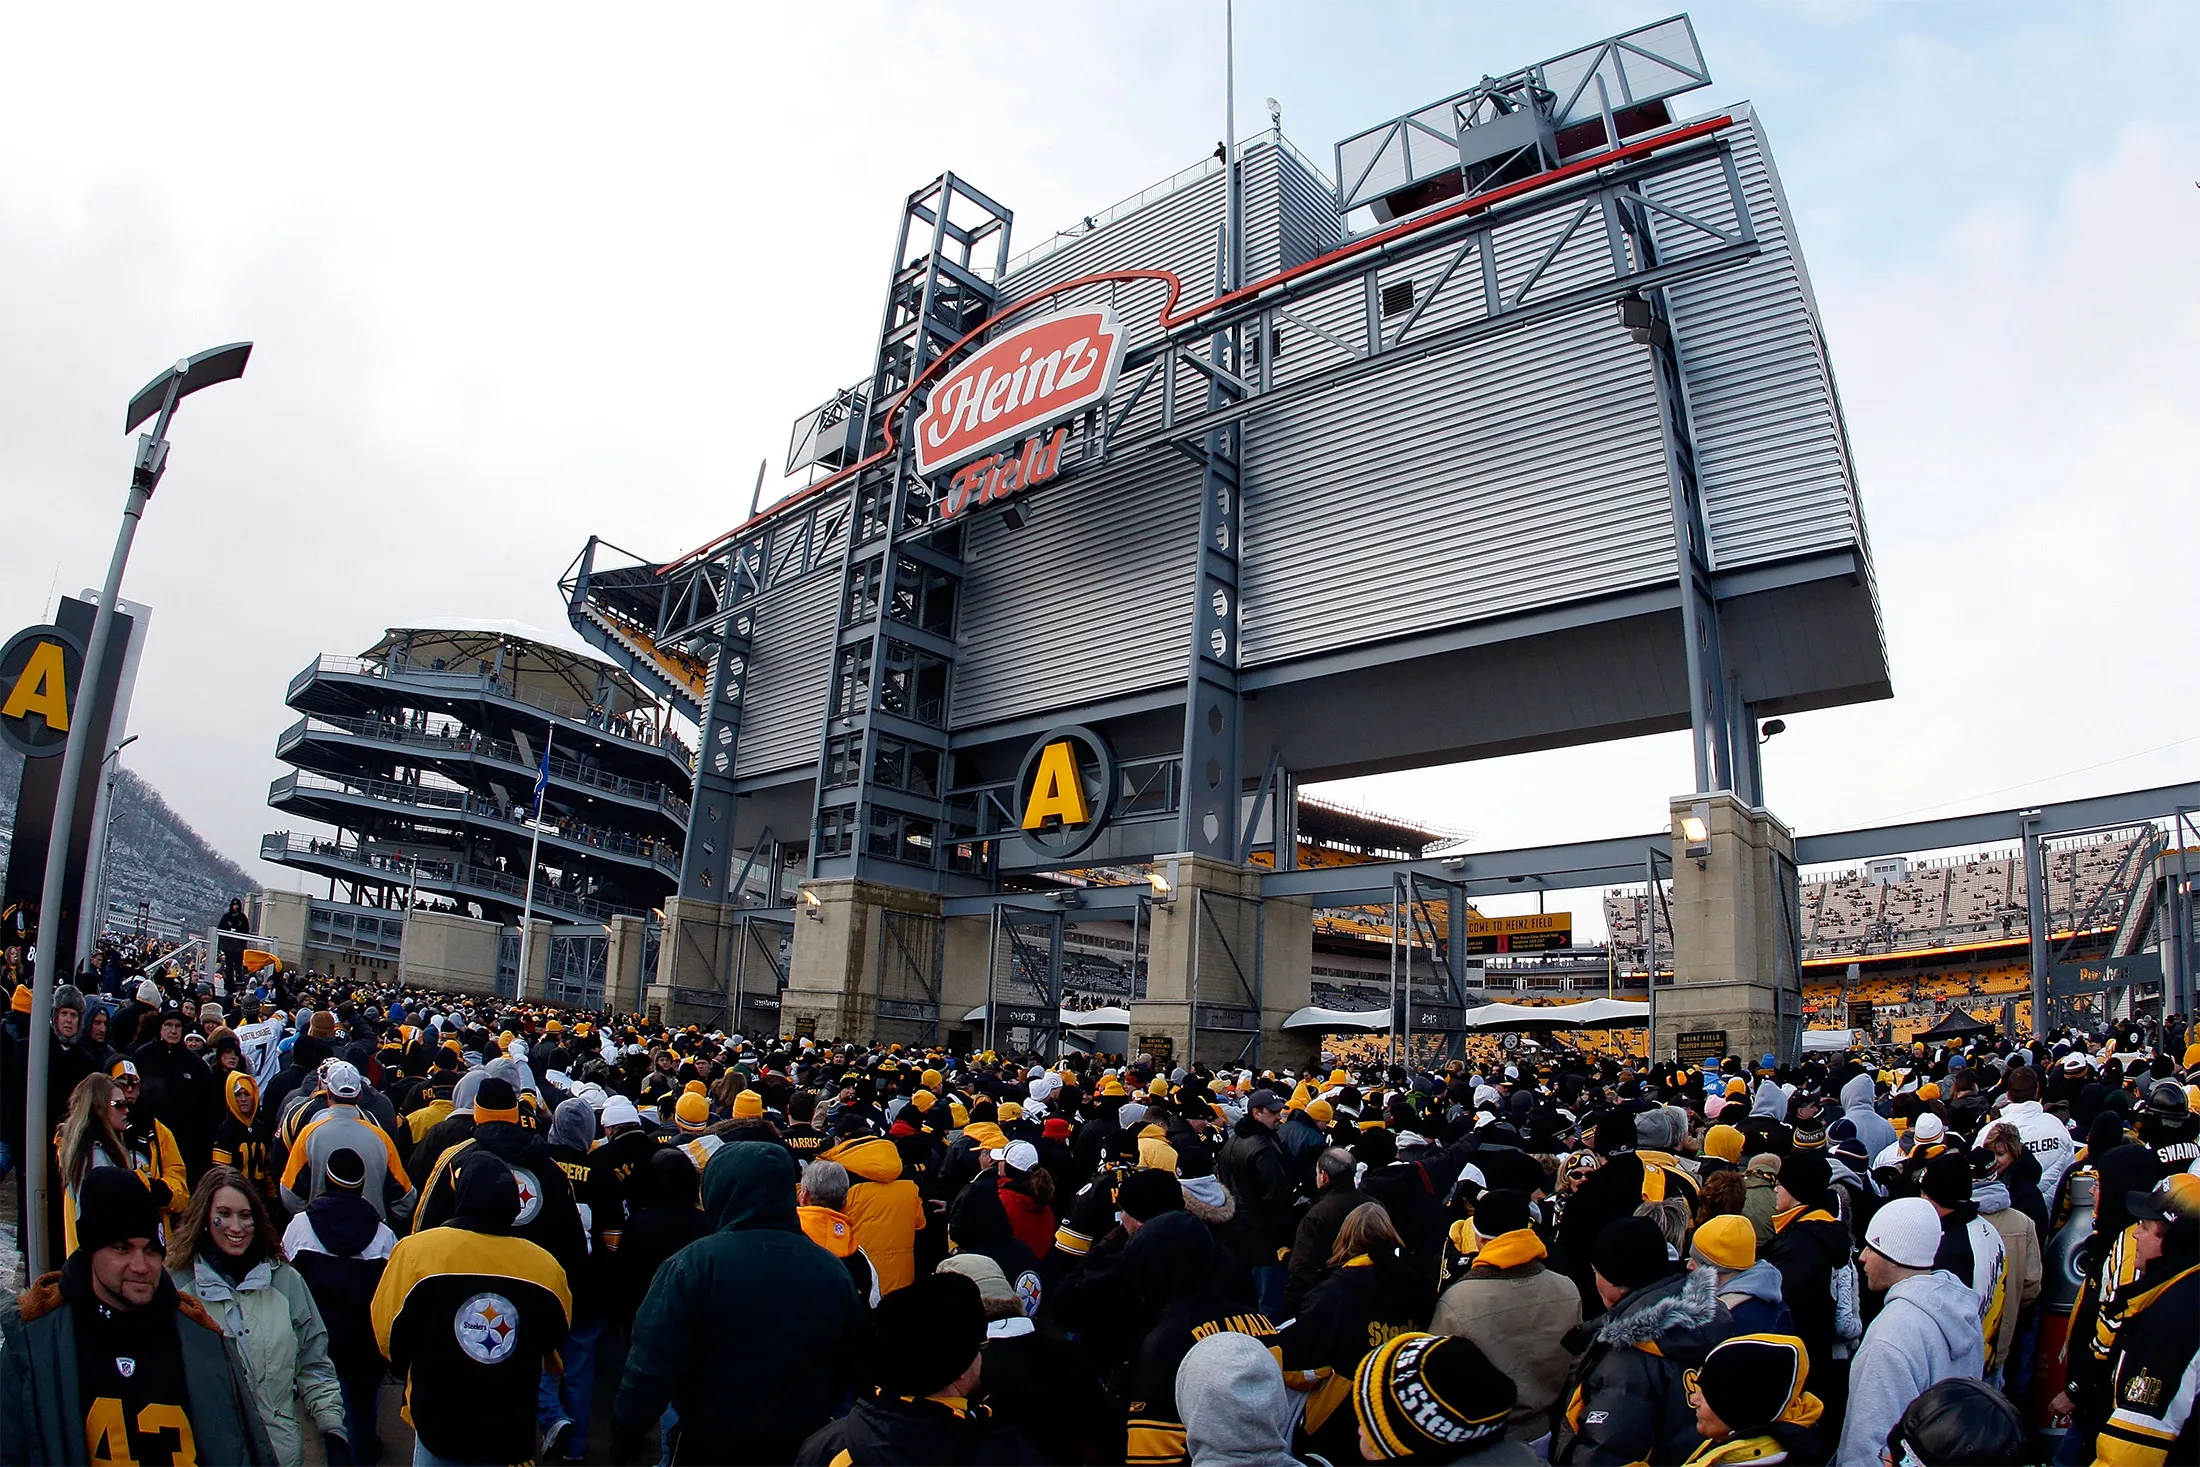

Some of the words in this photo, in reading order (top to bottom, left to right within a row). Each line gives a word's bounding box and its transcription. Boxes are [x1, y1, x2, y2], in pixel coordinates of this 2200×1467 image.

[928, 337, 1098, 447] Heinz
[940, 428, 1069, 519] Field
[1, 641, 70, 732] A
[1022, 741, 1089, 830] A
[1493, 920, 1502, 931] TO
[1506, 919, 1528, 930] HEINZ
[1532, 917, 1553, 928] FIELD
[256, 1043, 267, 1076] 7
[463, 1321, 487, 1331] Steelers
[86, 1397, 198, 1467] 43
